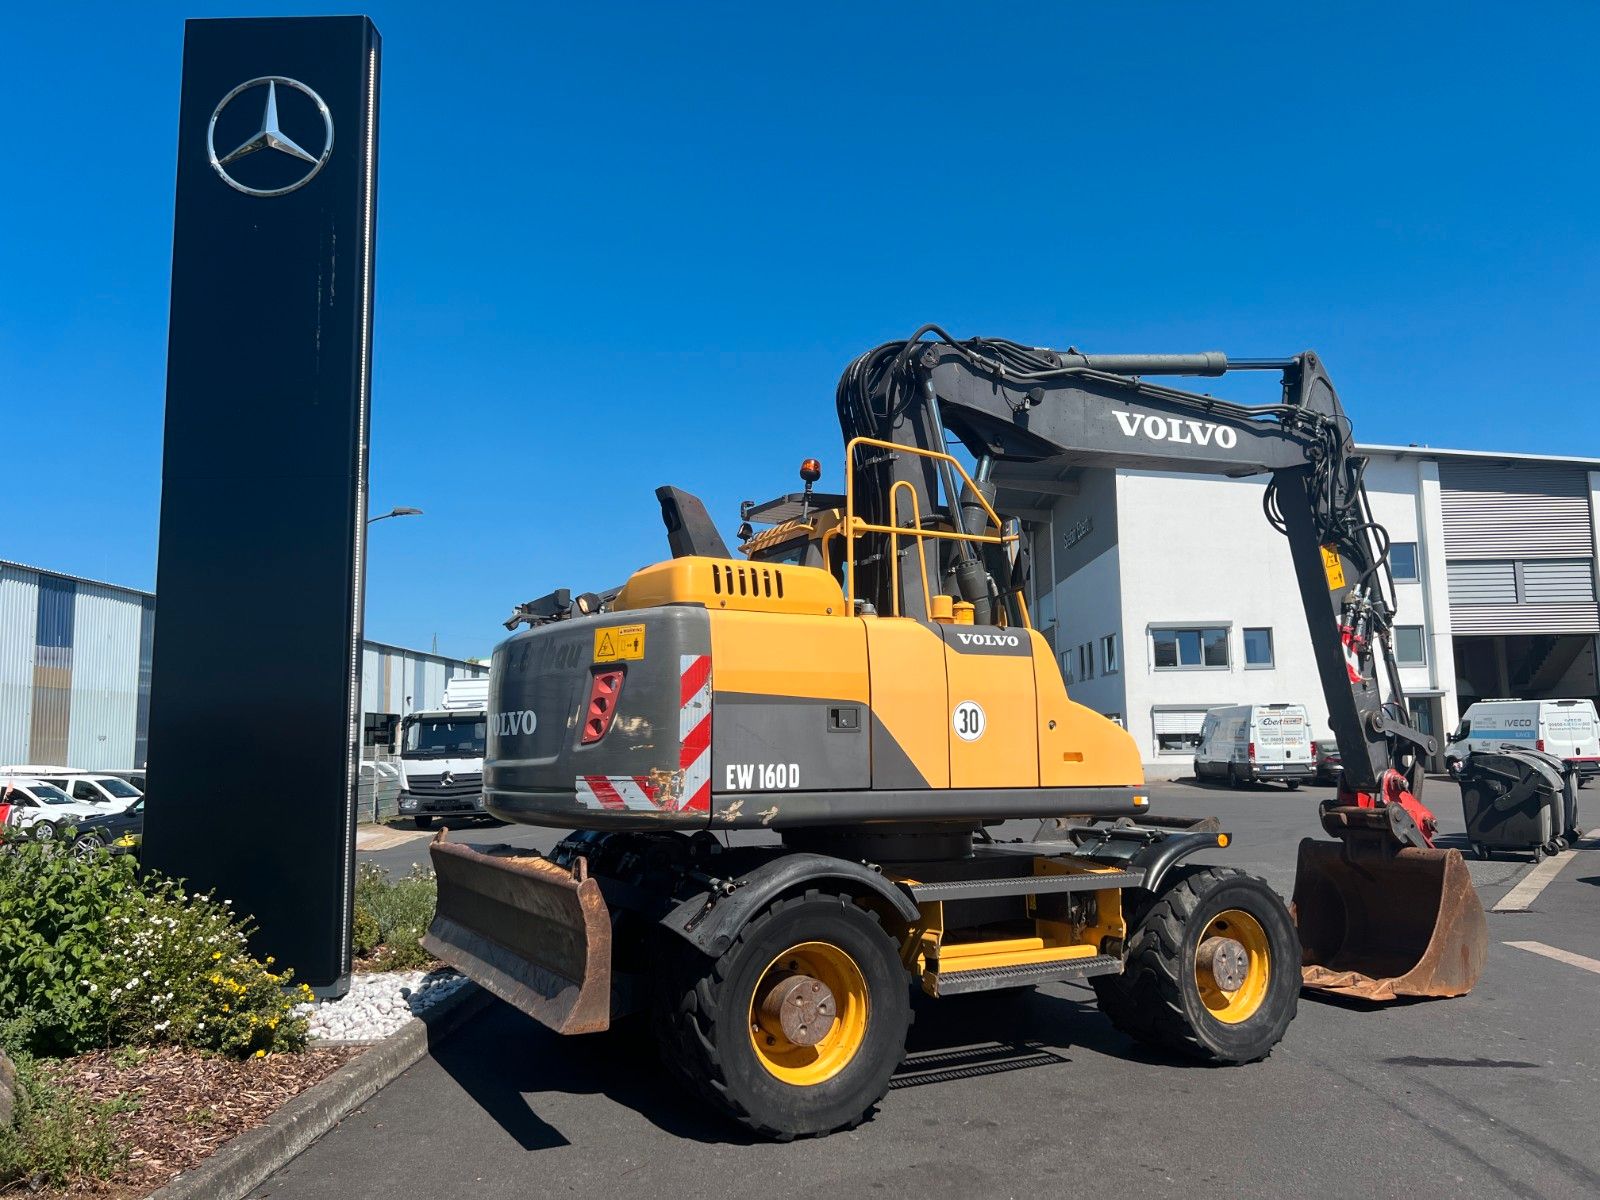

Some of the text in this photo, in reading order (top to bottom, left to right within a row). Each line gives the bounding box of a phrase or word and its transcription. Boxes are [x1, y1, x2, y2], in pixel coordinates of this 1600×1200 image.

[1112, 410, 1237, 449] VOLVO
[957, 634, 1019, 647] VOLVO
[959, 708, 979, 733] 30
[1504, 719, 1532, 727] IVECO
[726, 764, 755, 789] EW
